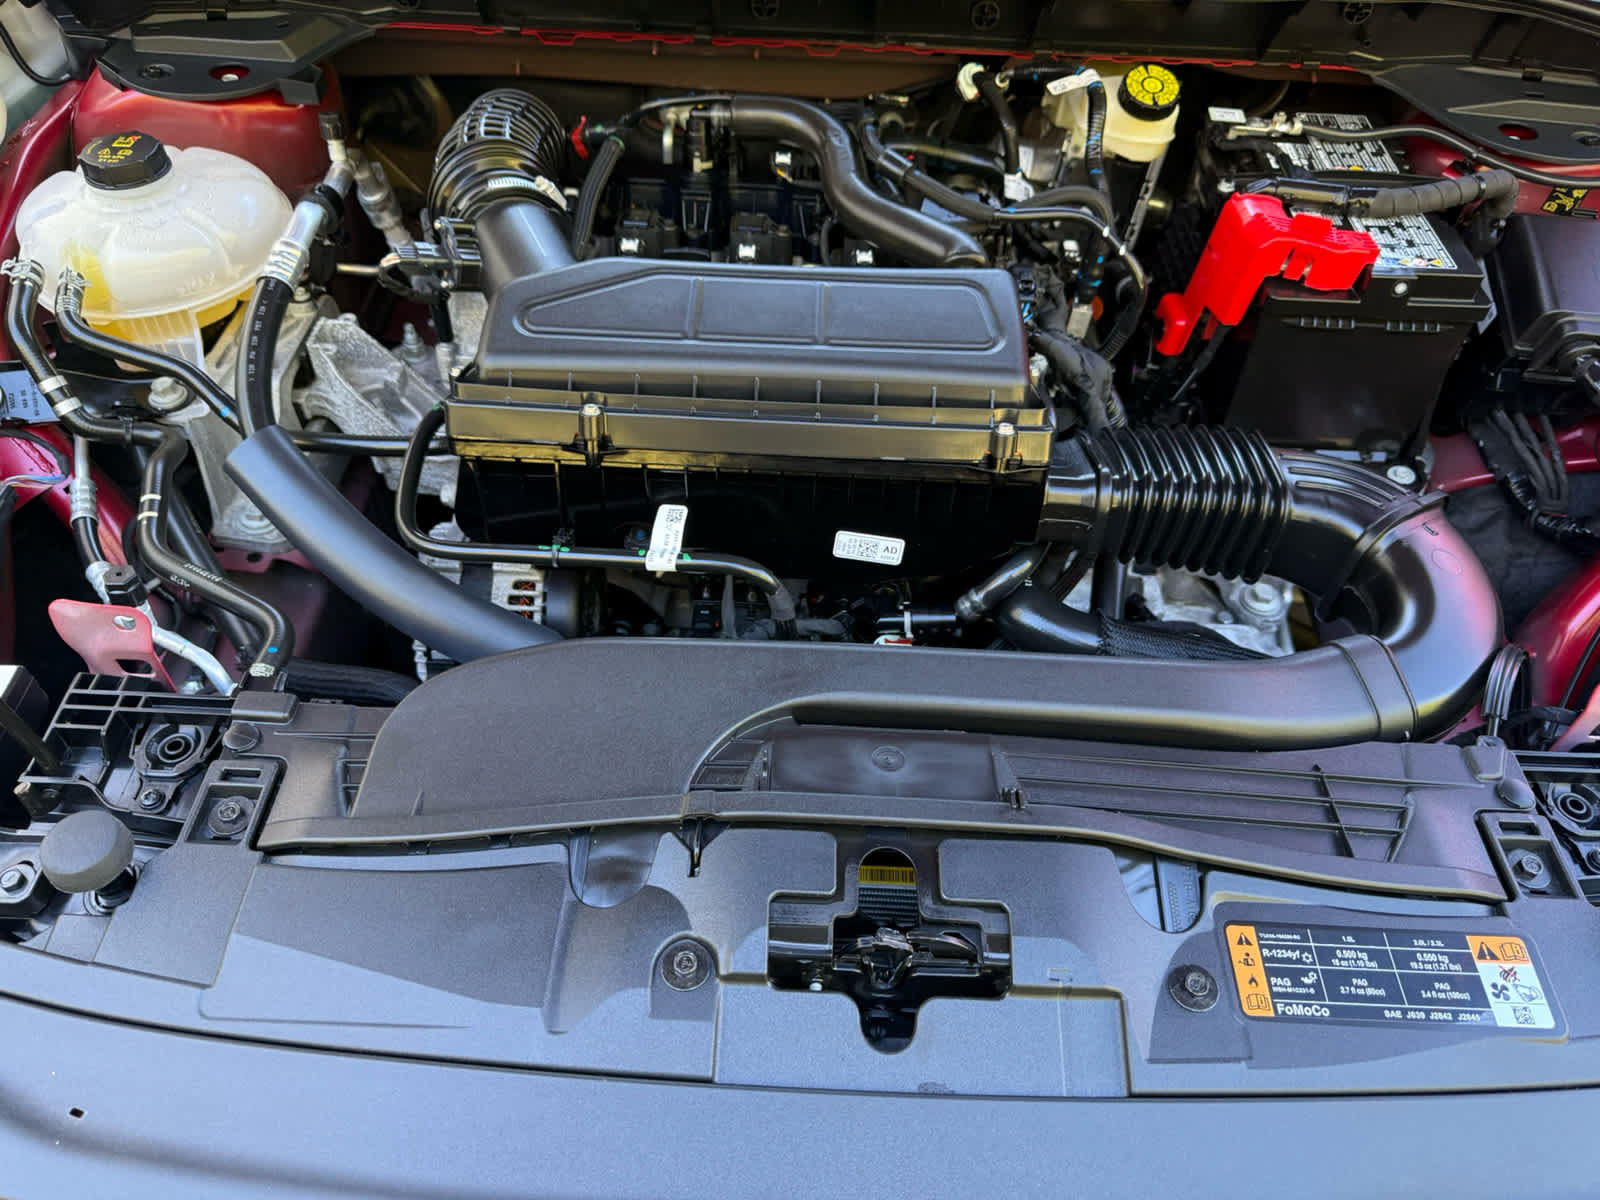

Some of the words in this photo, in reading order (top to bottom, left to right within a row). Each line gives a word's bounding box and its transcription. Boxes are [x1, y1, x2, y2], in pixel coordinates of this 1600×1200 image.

[883, 546, 898, 554] AD
[1262, 948, 1300, 960] R-1234yf
[1357, 950, 1368, 961] kg
[1438, 953, 1449, 964] kg
[1270, 977, 1291, 986] PAG
[1352, 978, 1368, 986] PAG
[1433, 982, 1451, 990] PAG
[1276, 1003, 1330, 1016] FoMoCo
[1384, 1009, 1402, 1018] SAE
